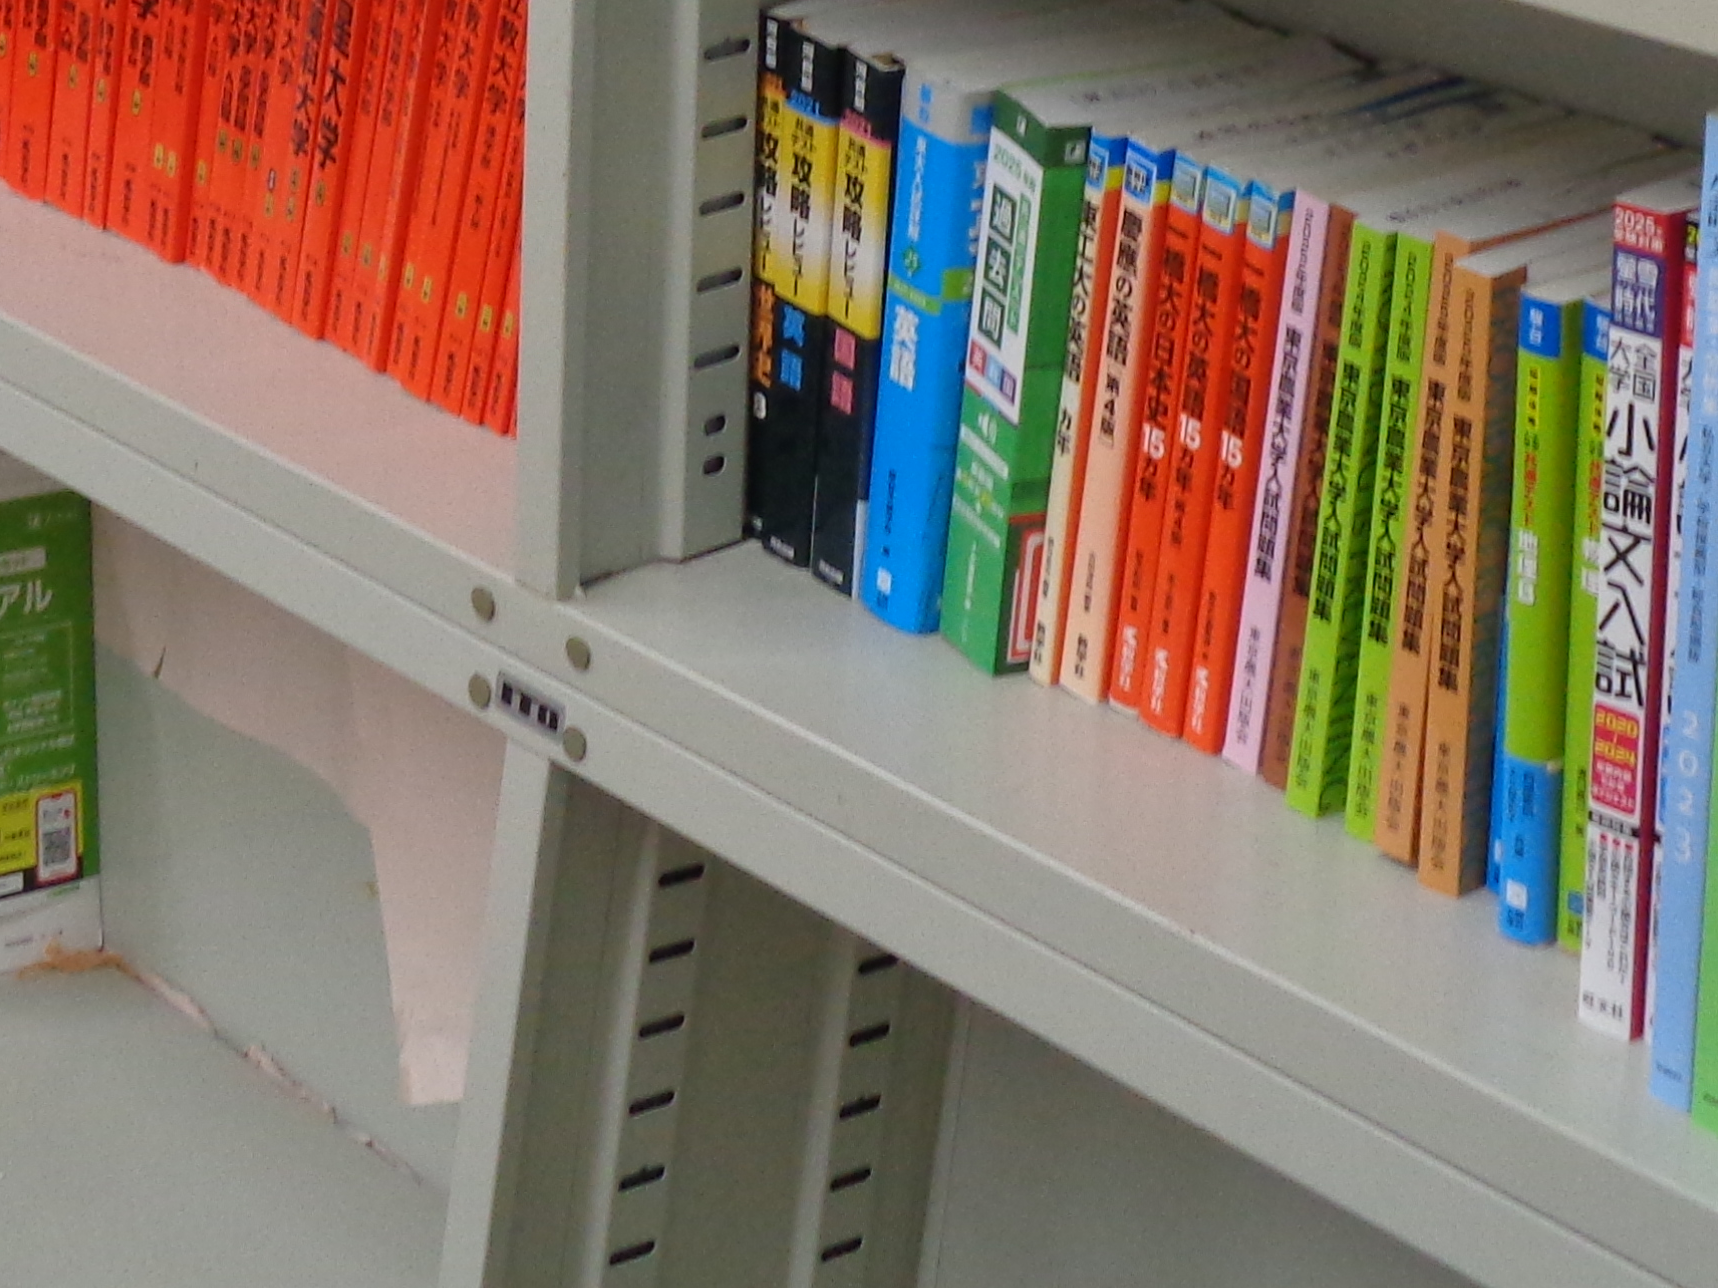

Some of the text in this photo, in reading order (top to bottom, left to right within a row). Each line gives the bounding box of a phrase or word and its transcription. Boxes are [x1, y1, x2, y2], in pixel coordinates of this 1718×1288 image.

[980, 188, 1018, 349] 過去問
[1593, 402, 1656, 709] 小論文入試
